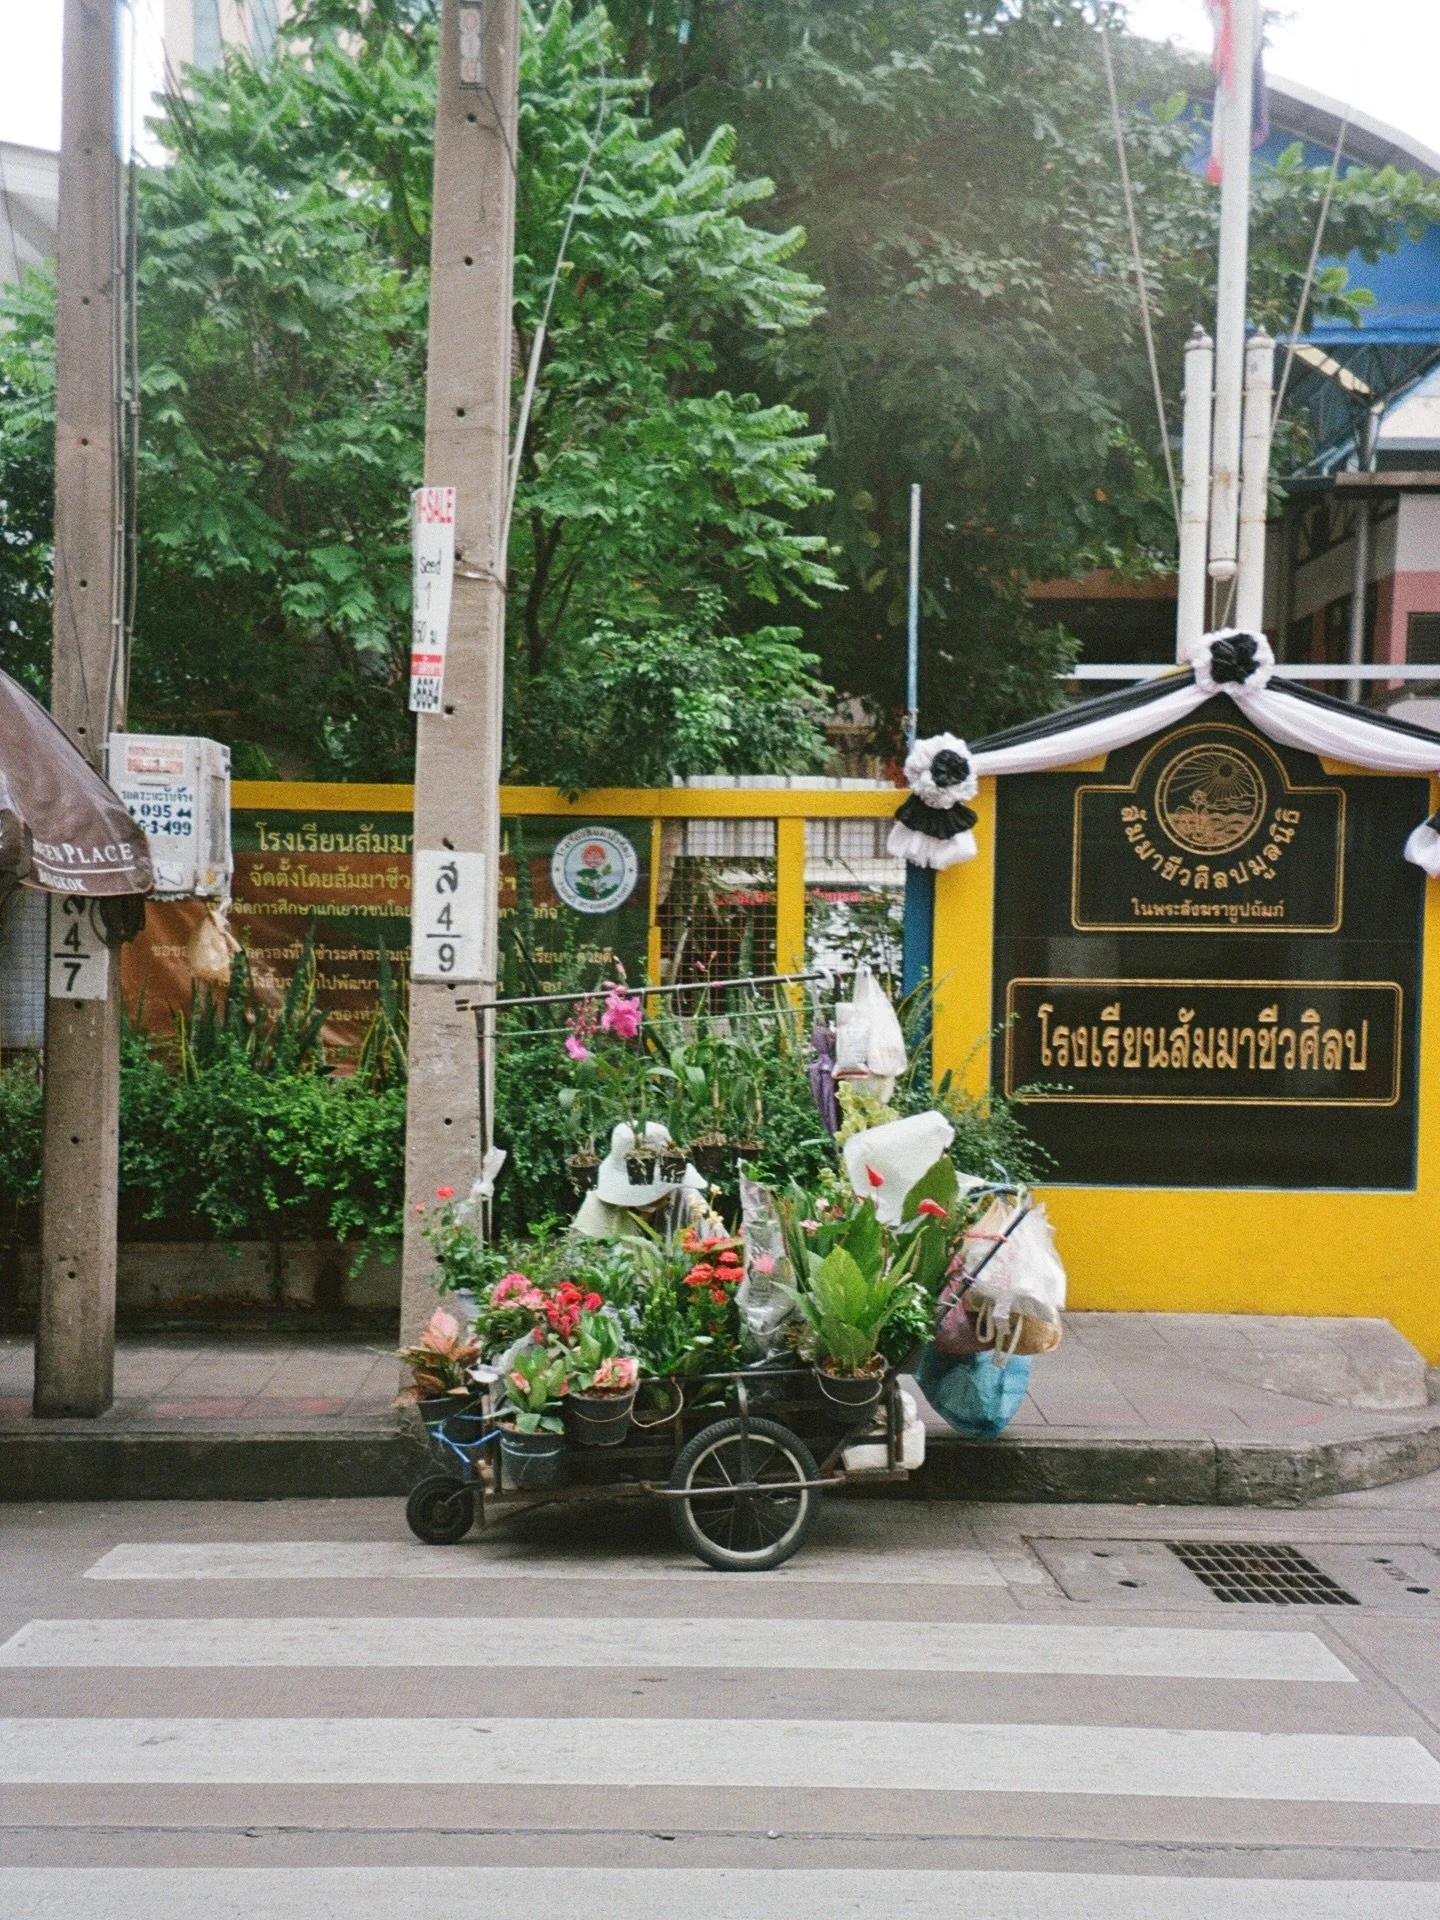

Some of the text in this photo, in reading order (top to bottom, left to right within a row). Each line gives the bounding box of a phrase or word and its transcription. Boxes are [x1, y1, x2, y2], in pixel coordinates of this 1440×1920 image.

[140, 804, 173, 817] 095
[1120, 805, 1301, 890] สัมมาชีวศิลปมูลนิธิ
[436, 903, 454, 932] 4
[63, 922, 82, 952] 4
[437, 942, 456, 973] 9
[63, 962, 82, 992] 7
[1037, 1002, 1369, 1072] โรงเรียนสัมมาชีวศิลป
